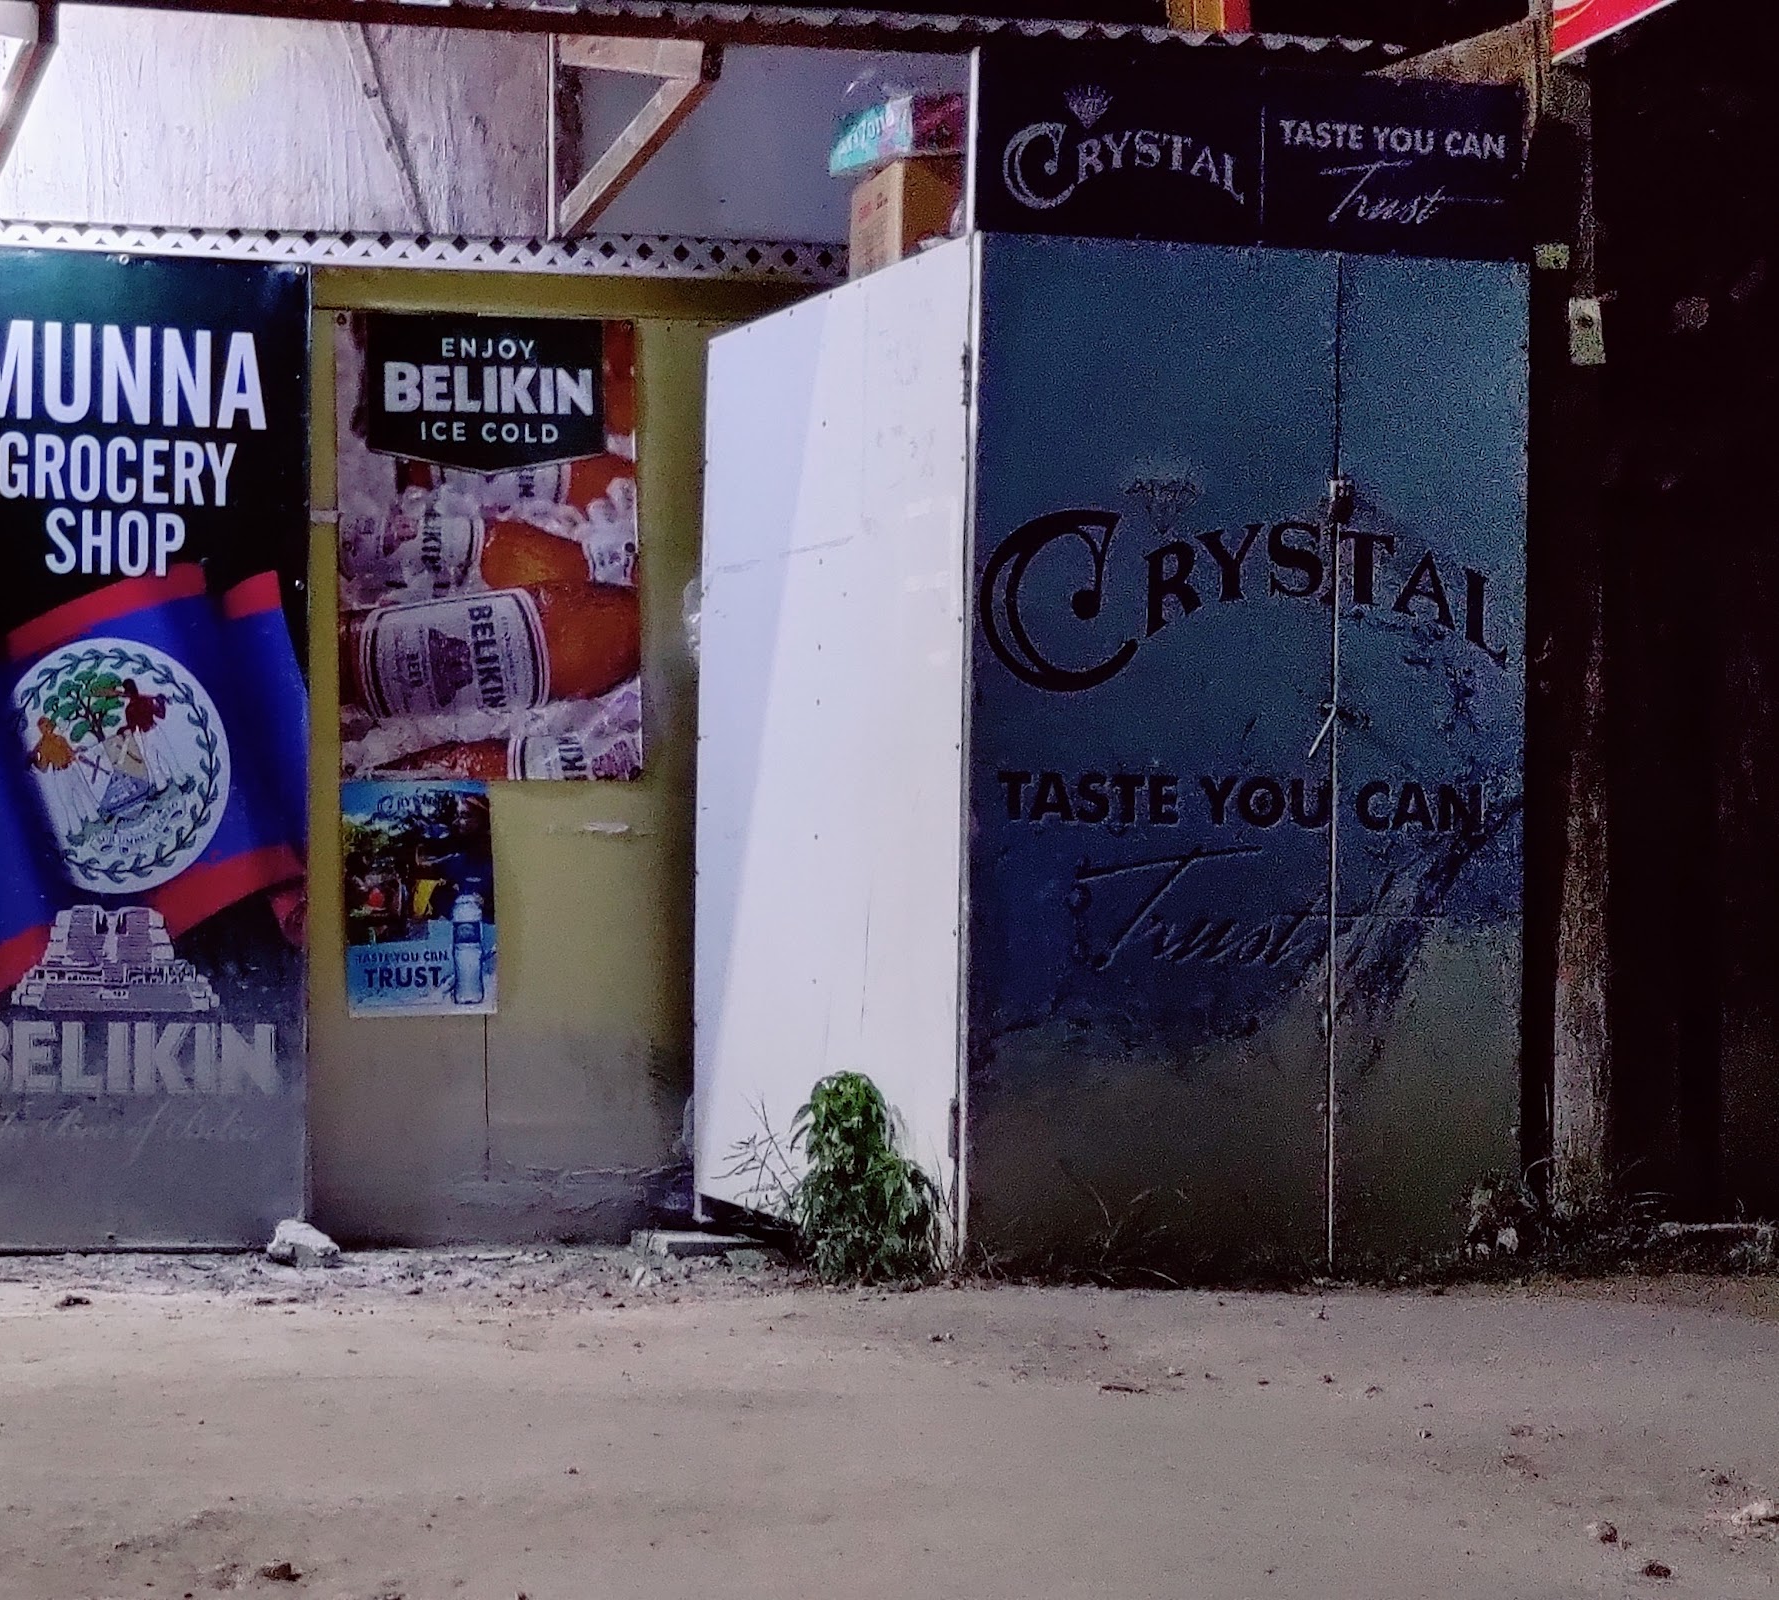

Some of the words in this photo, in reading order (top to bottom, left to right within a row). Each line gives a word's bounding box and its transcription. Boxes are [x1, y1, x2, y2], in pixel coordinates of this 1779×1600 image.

[1003, 121, 1244, 209] CRYSTAL
[1279, 118, 1363, 151] TASTE
[1372, 125, 1434, 157] YOU
[1444, 129, 1506, 160] CAN
[1320, 158, 1504, 225] Trust
[441, 338, 535, 359] ENJOY
[383, 361, 594, 416] BELIKIN
[421, 421, 467, 441] ICE
[481, 422, 559, 444] COLD
[45, 508, 185, 577] SHOP
[980, 509, 1507, 692] CRYSTAL
[468, 604, 507, 709] BELIKIN
[997, 771, 1179, 826] TASTE
[1198, 775, 1331, 828] YOU
[1355, 780, 1484, 836] CAN
[1071, 844, 1432, 970] Trust
[355, 950, 393, 966] TASTE
[394, 950, 419, 964] YOU
[423, 949, 450, 962] CAN
[364, 965, 443, 989] TRUST
